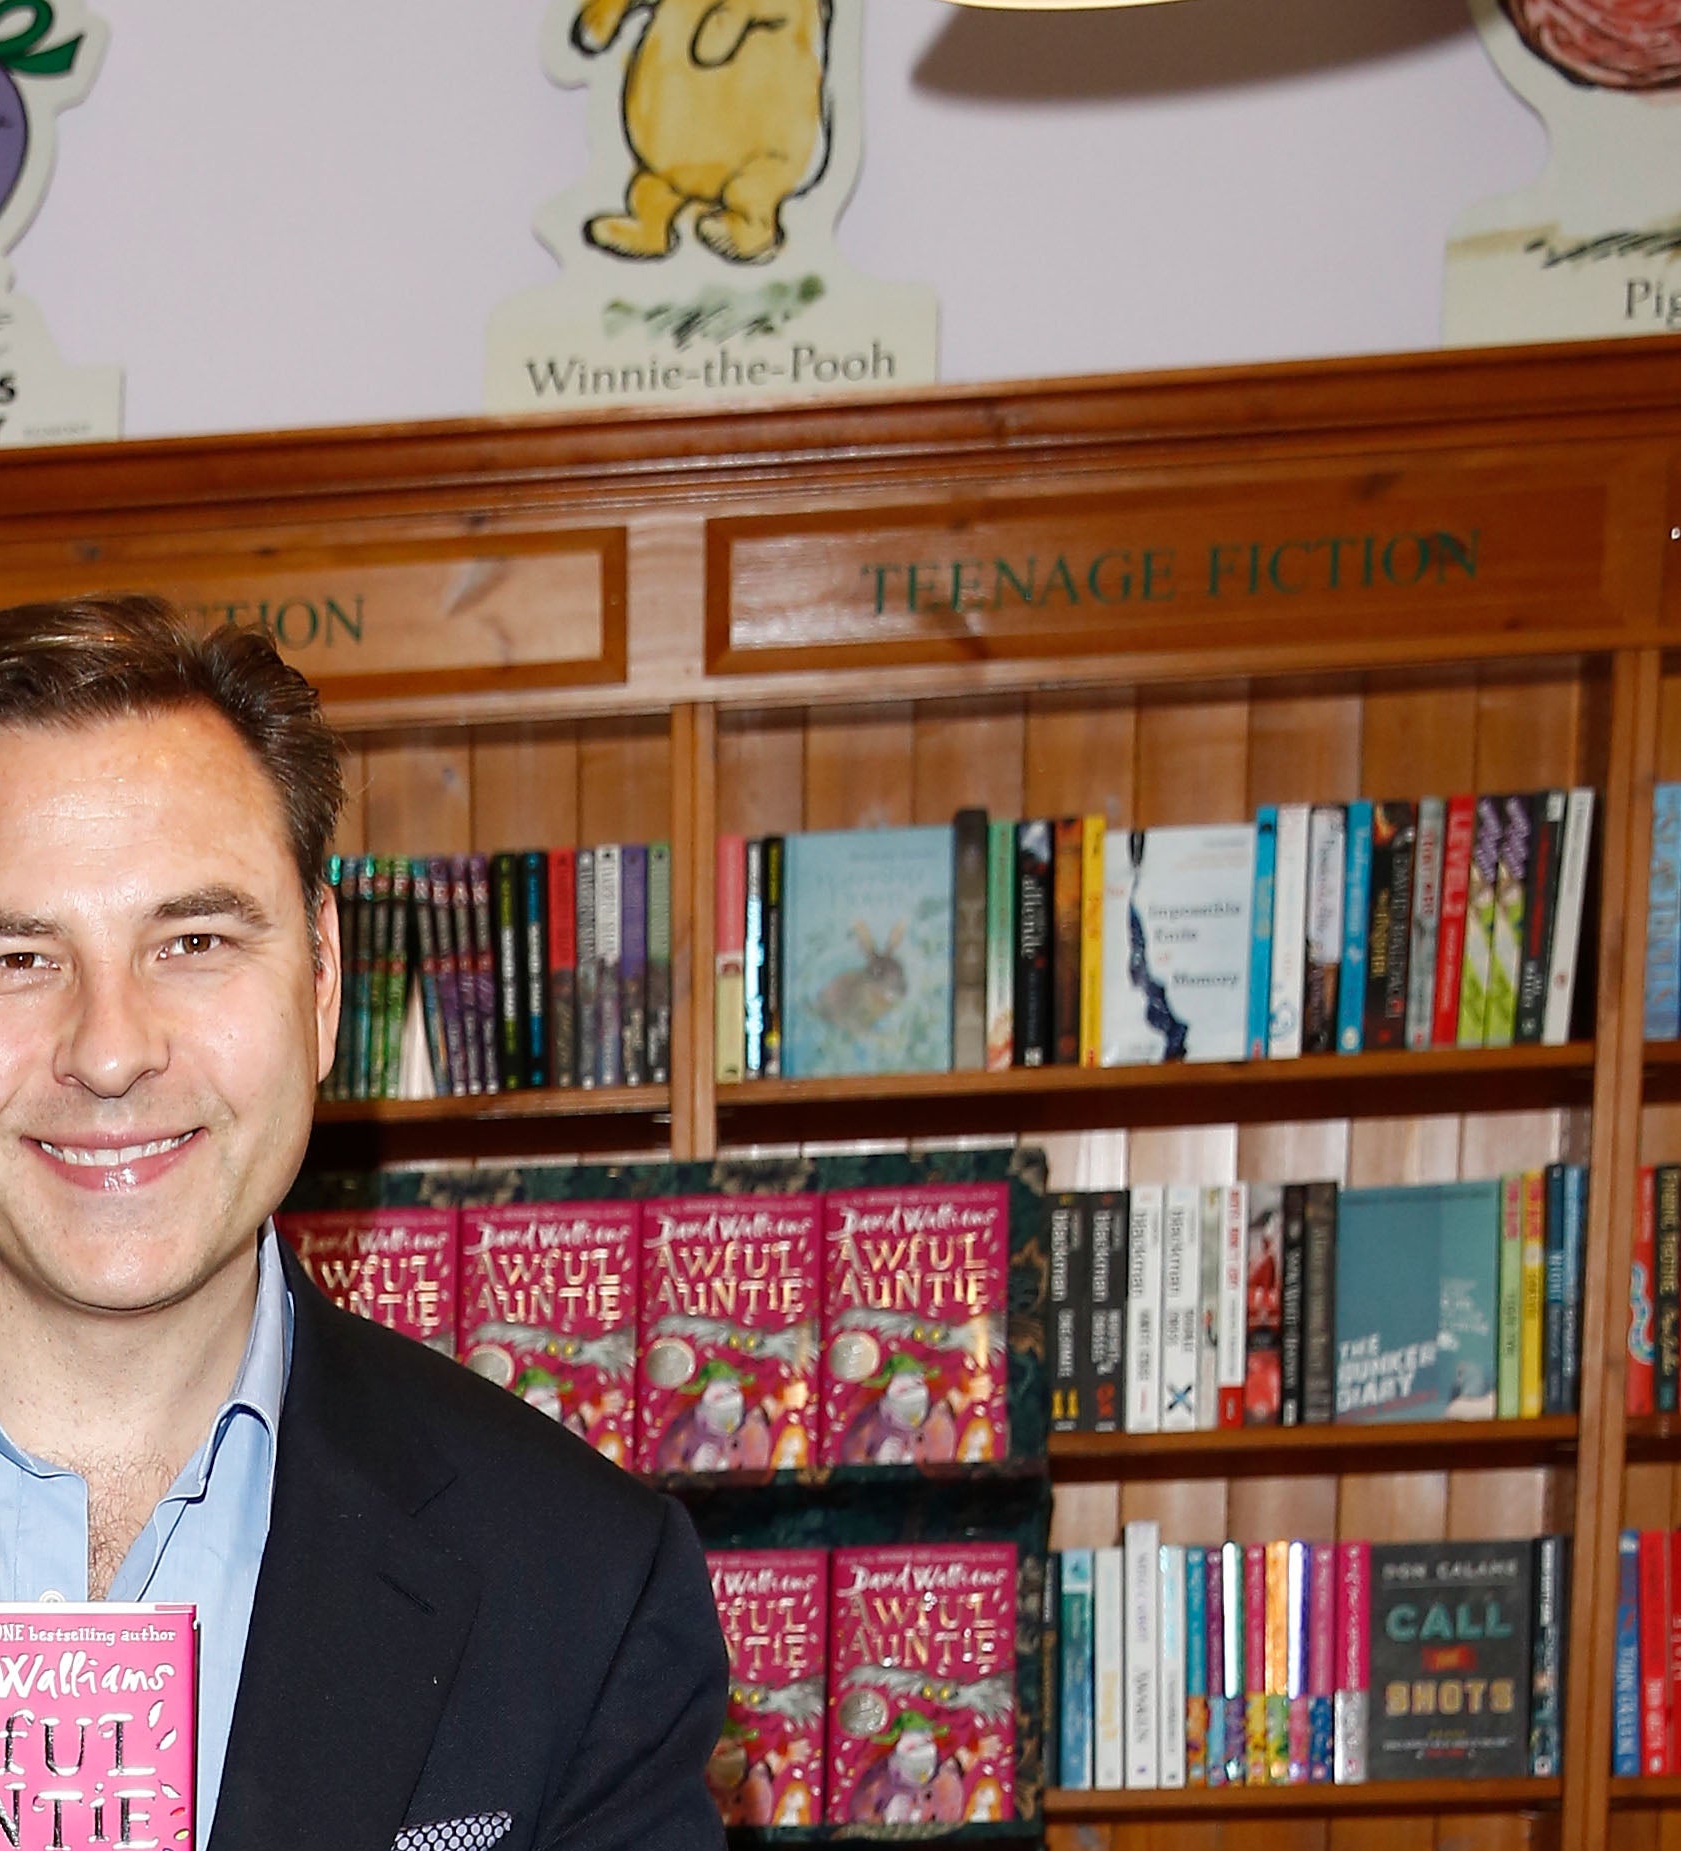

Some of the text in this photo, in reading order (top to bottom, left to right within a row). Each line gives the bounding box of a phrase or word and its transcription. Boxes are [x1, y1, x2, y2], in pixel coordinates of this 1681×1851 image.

[522, 344, 896, 397] Winnie-the-Pooh
[859, 530, 1481, 617] TEENAGE FICTION
[657, 1241, 803, 1280] AWFUL
[839, 1232, 988, 1276] AWFUL
[656, 1275, 804, 1315] AUNTIE
[837, 1268, 989, 1310] AUNTIE
[1340, 1333, 1380, 1361] THE
[28, 1625, 116, 1646] bestselling
[120, 1625, 176, 1642] author
[1386, 1601, 1514, 1642] CALL
[1385, 1678, 1516, 1717] SHOTS
